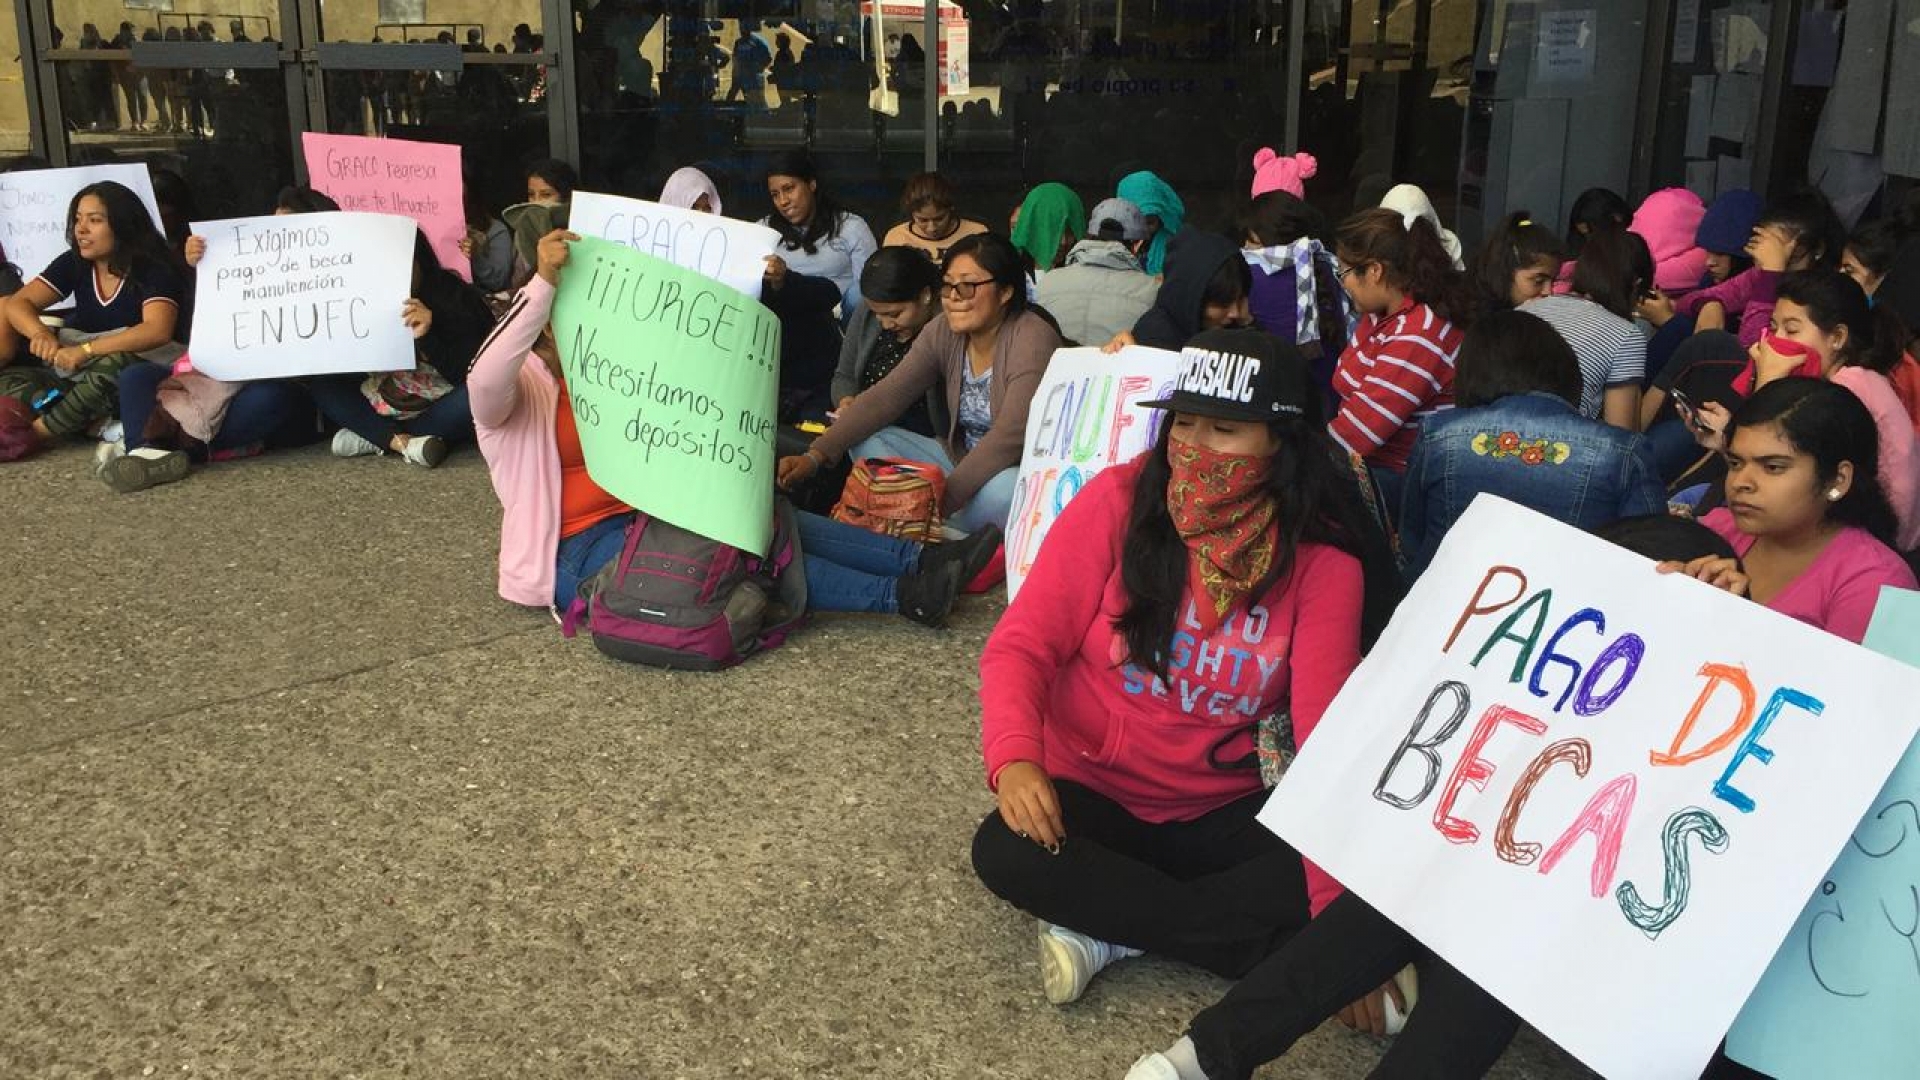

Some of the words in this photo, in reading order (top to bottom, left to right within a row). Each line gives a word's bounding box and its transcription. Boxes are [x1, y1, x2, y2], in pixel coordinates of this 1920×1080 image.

[216, 265, 265, 292] pago
[280, 257, 300, 274] de
[310, 251, 353, 270] beca
[234, 224, 330, 267] Exigimos
[569, 323, 725, 423] Necesitamos
[1442, 564, 1646, 717] PAGO
[1648, 660, 1825, 813] DE
[1372, 680, 1730, 941] BECAS
